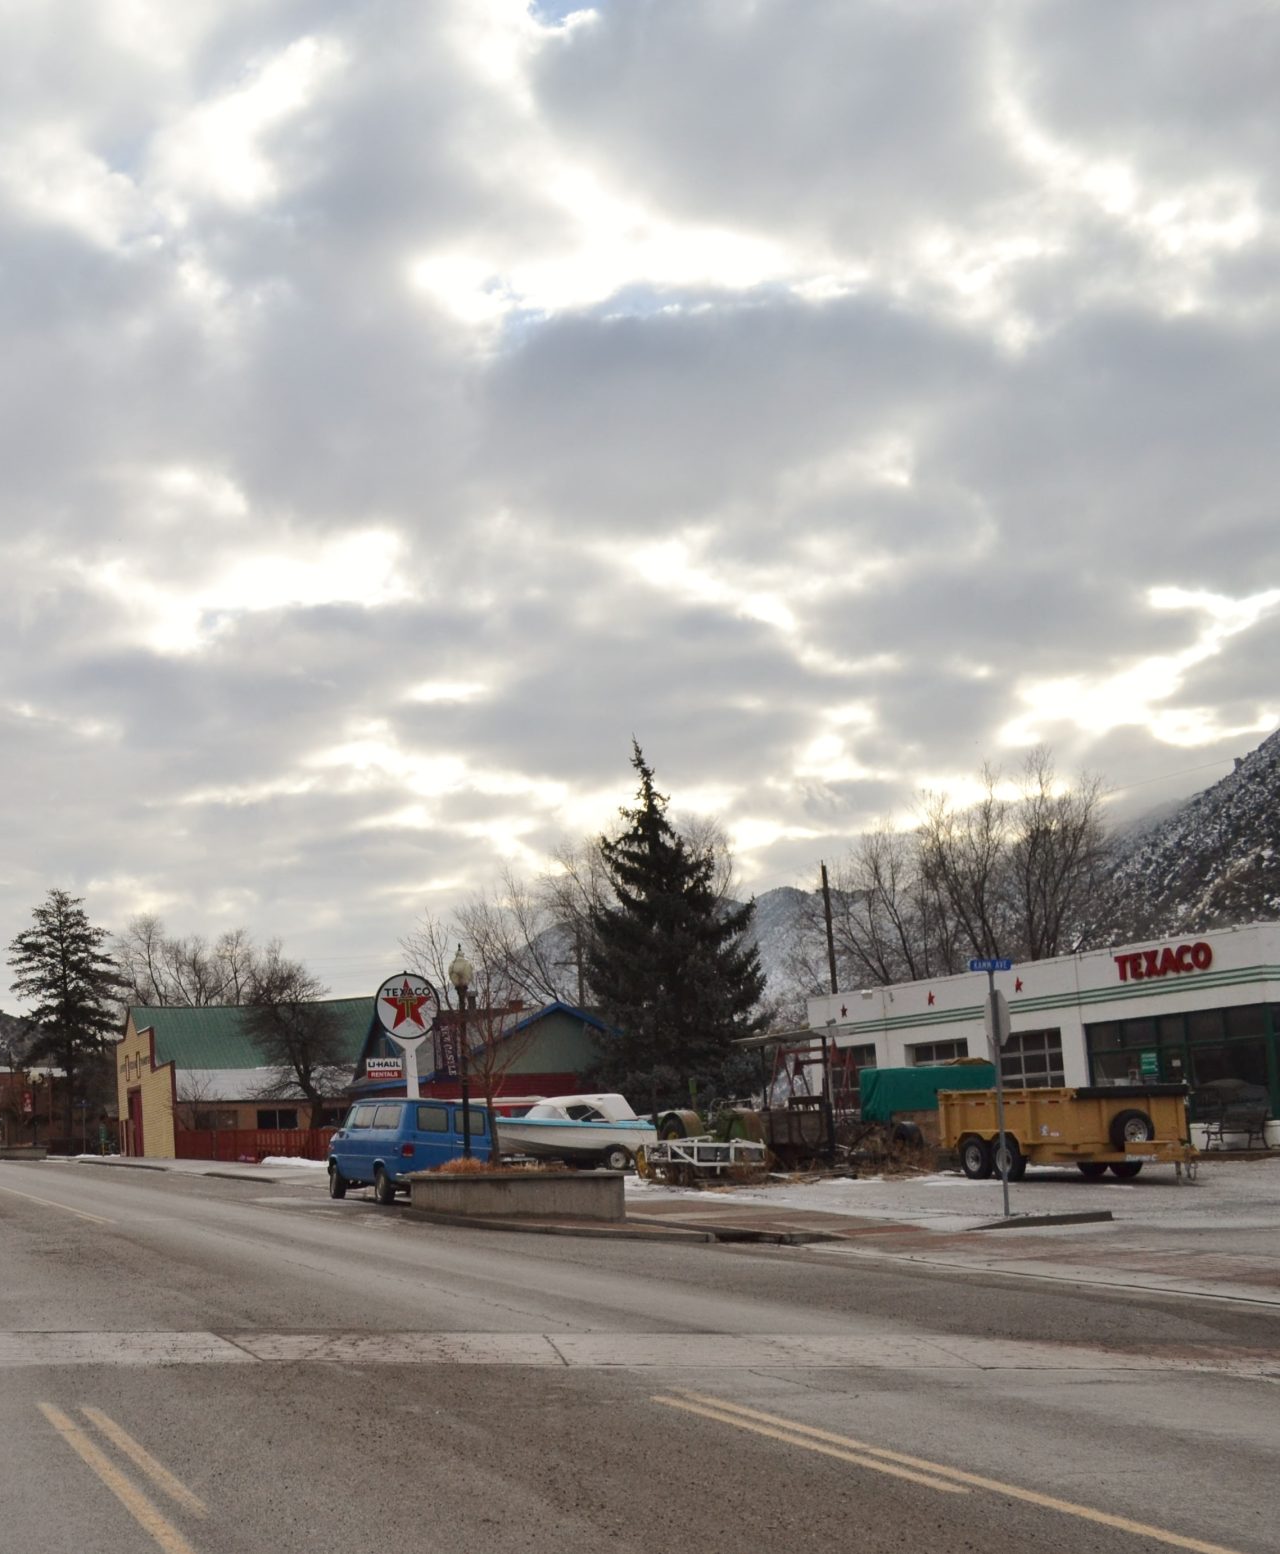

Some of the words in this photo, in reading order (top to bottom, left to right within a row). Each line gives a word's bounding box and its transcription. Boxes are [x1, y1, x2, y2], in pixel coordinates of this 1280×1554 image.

[995, 960, 1008, 969] AVE
[1114, 942, 1212, 981] TEXACO
[384, 987, 431, 997] TEXACO
